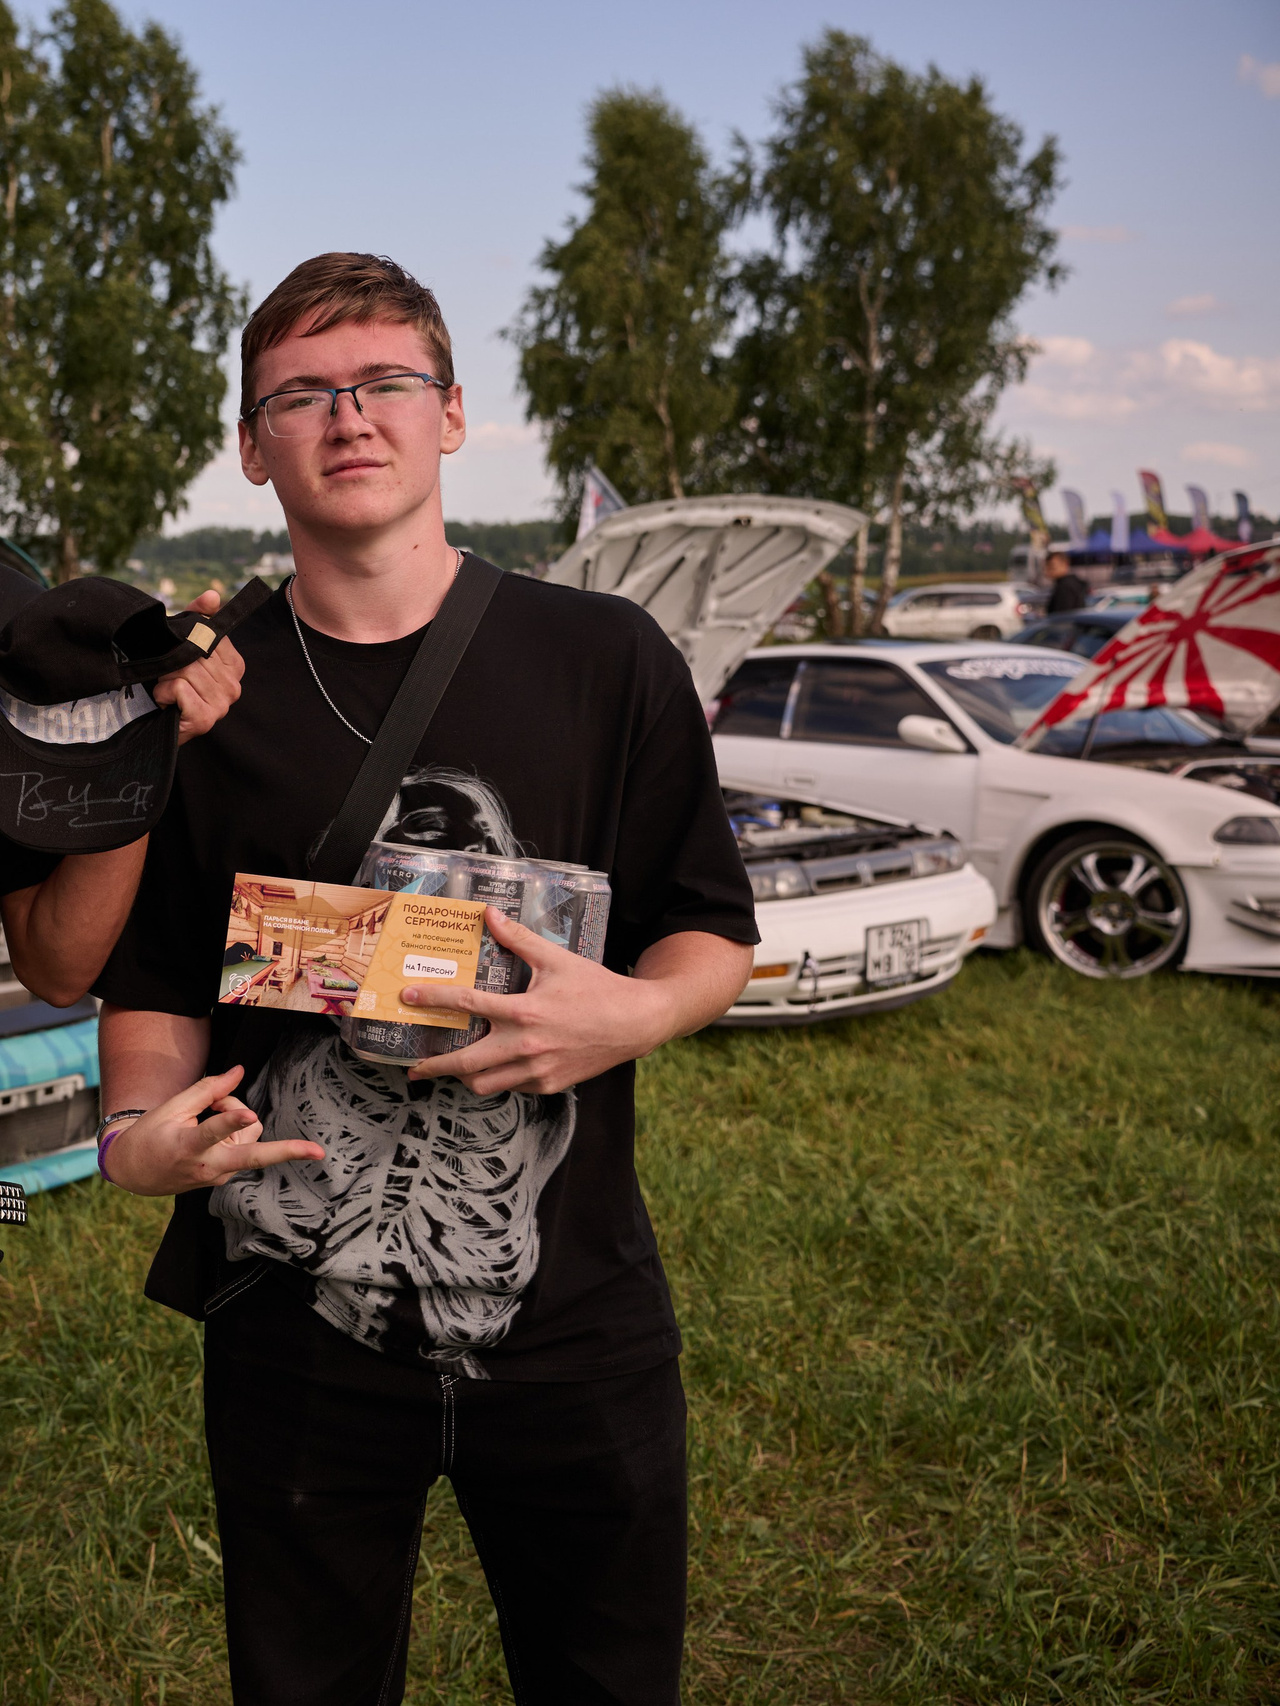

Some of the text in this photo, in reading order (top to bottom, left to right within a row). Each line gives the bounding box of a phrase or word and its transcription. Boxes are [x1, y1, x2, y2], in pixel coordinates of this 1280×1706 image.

[381, 868, 419, 879] ENERGY
[403, 903, 481, 921] ПОДАРОЧНЫЙ
[273, 922, 310, 932] СОЛНЕЧНОЙ
[311, 927, 336, 935] ПОЛЯНЕ
[405, 916, 477, 933] СЕРТИФИКАТ
[422, 934, 465, 945] посещение
[401, 941, 473, 956] банного комплекса
[405, 963, 455, 976] НА 1 ПЕРСОНУ
[366, 1025, 387, 1035] TARGET
[367, 1031, 386, 1043] GOALS
